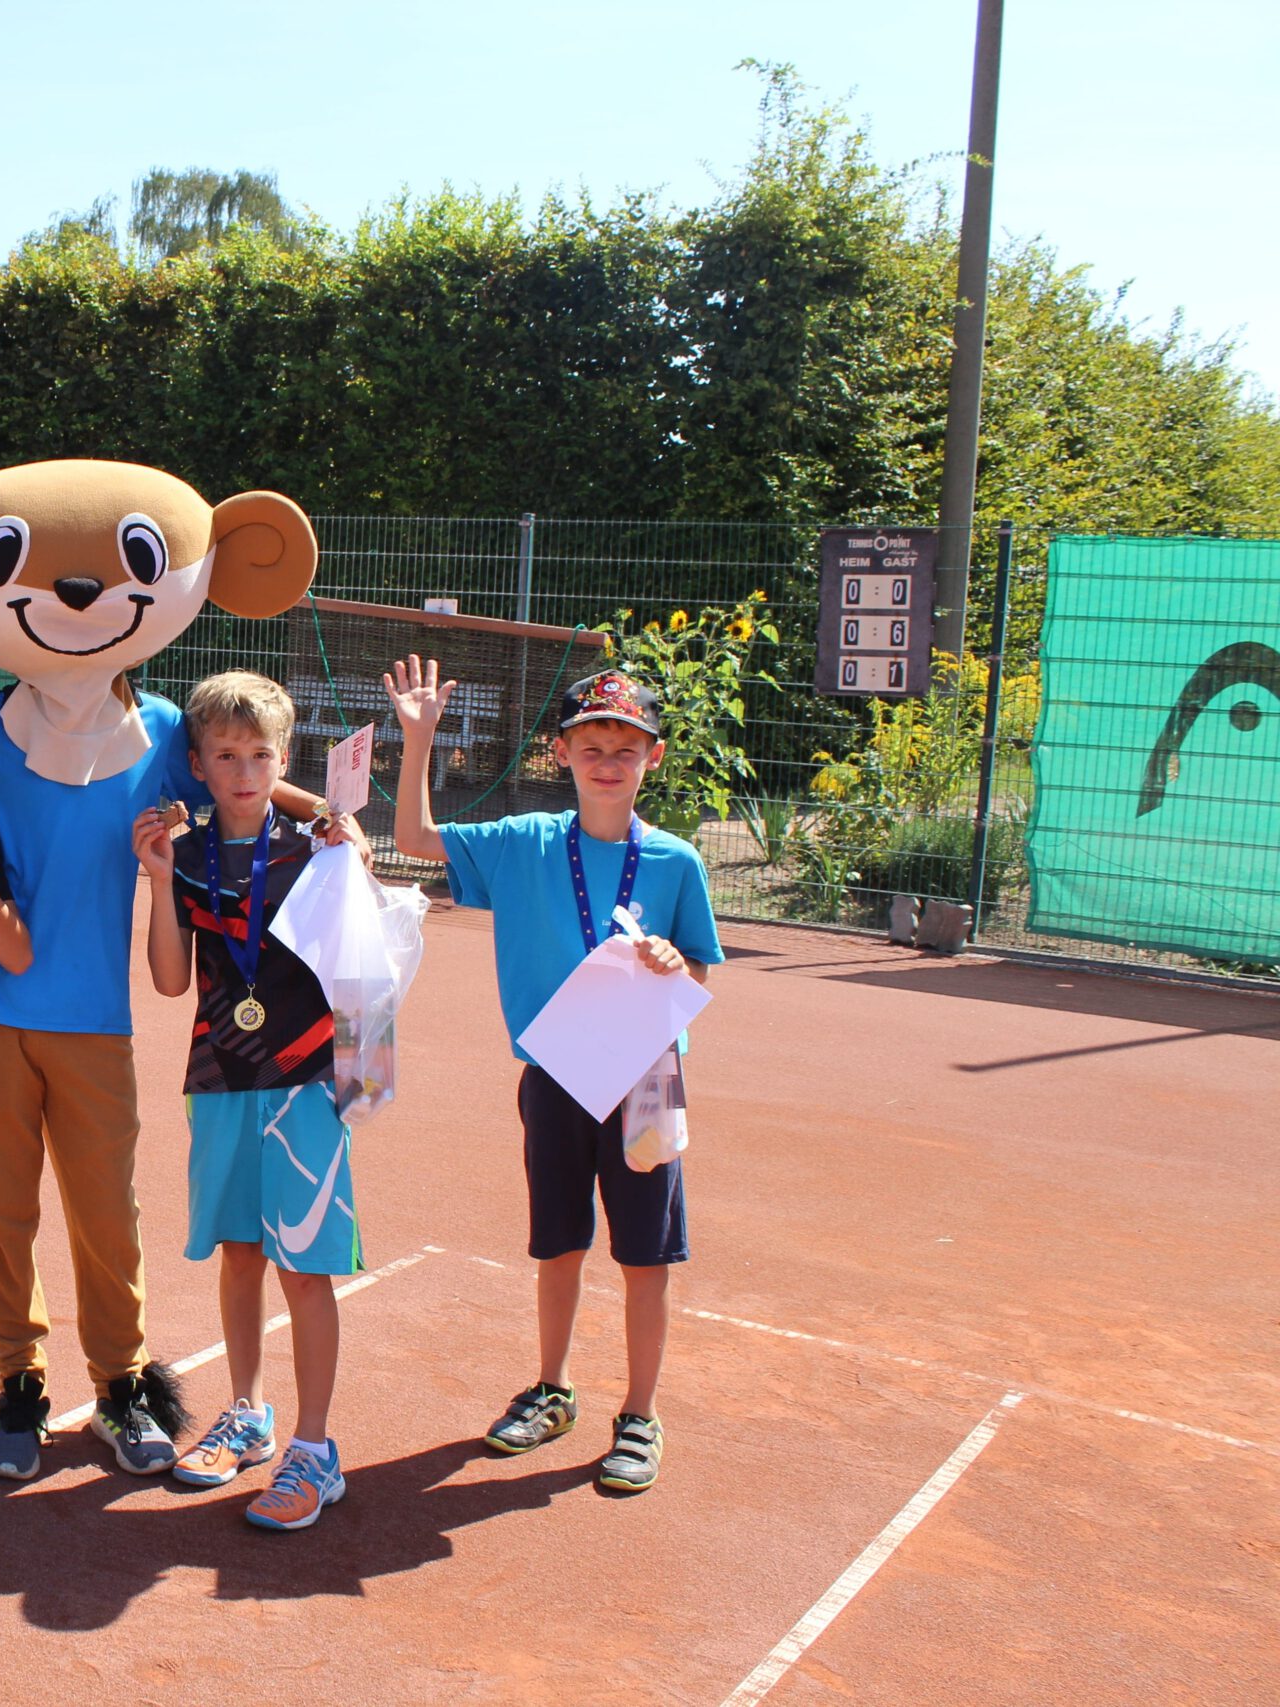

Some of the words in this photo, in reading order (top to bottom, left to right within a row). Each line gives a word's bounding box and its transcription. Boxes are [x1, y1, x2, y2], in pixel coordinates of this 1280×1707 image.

[848, 538, 873, 549] TENNIS
[839, 557, 871, 567] HEIM
[882, 557, 918, 567] GAST
[849, 582, 858, 601] 0
[894, 582, 903, 601] 0
[847, 623, 856, 642] 0
[893, 623, 902, 643] 6
[846, 663, 855, 682] 0
[890, 664, 897, 683] 1
[353, 732, 365, 748] 10
[351, 747, 364, 771] Euro
